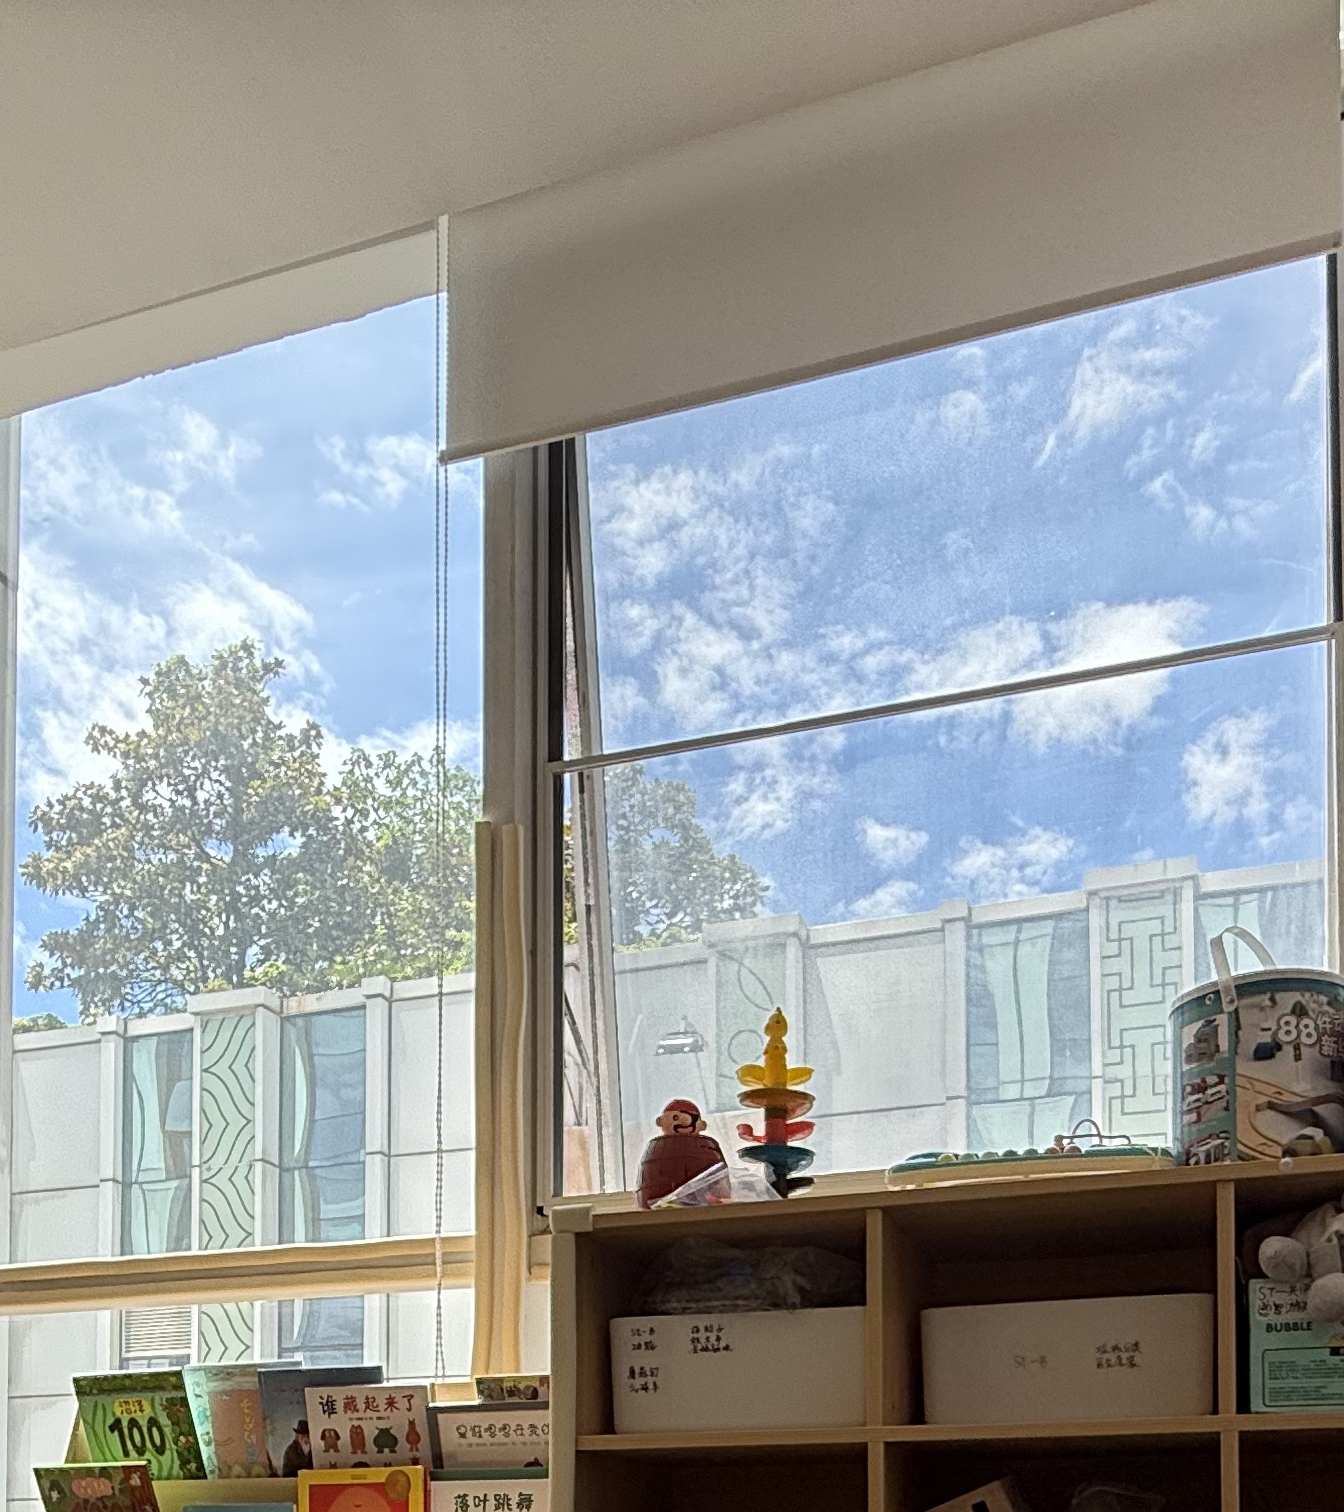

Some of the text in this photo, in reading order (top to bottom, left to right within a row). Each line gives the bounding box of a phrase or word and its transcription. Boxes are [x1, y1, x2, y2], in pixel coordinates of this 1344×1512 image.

[1278, 1014, 1318, 1046] 88
[1265, 1321, 1313, 1334] BUBBLE
[318, 1394, 415, 1419] 谁藏起来了
[109, 1416, 166, 1458] 100
[454, 1492, 534, 1512] 落叶跳舞
